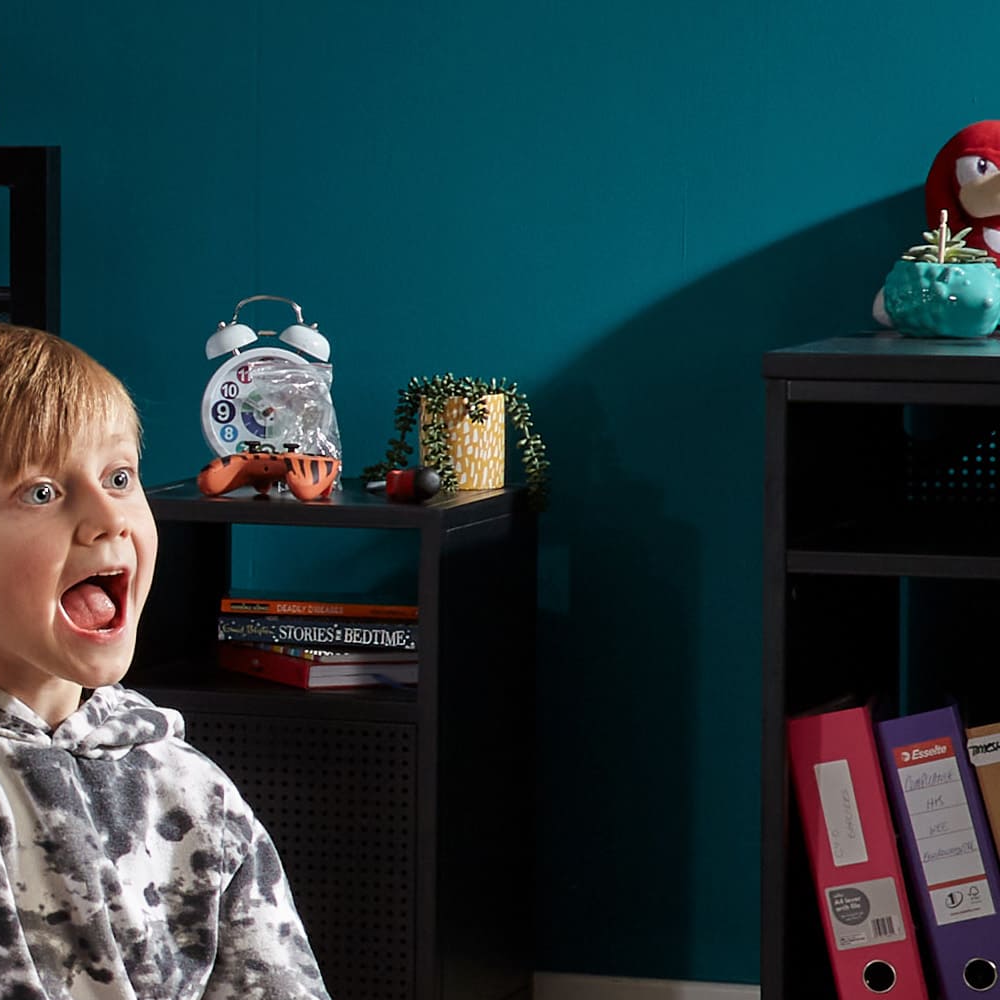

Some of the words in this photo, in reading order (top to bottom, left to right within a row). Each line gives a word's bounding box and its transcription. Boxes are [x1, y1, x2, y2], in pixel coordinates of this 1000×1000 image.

[222, 383, 238, 397] 10
[217, 403, 230, 421] 9
[225, 427, 234, 440] 8
[276, 604, 306, 614] DEADLY
[279, 624, 334, 642] STORIES
[344, 628, 406, 647] BEDTIME
[911, 745, 947, 760] Esselte
